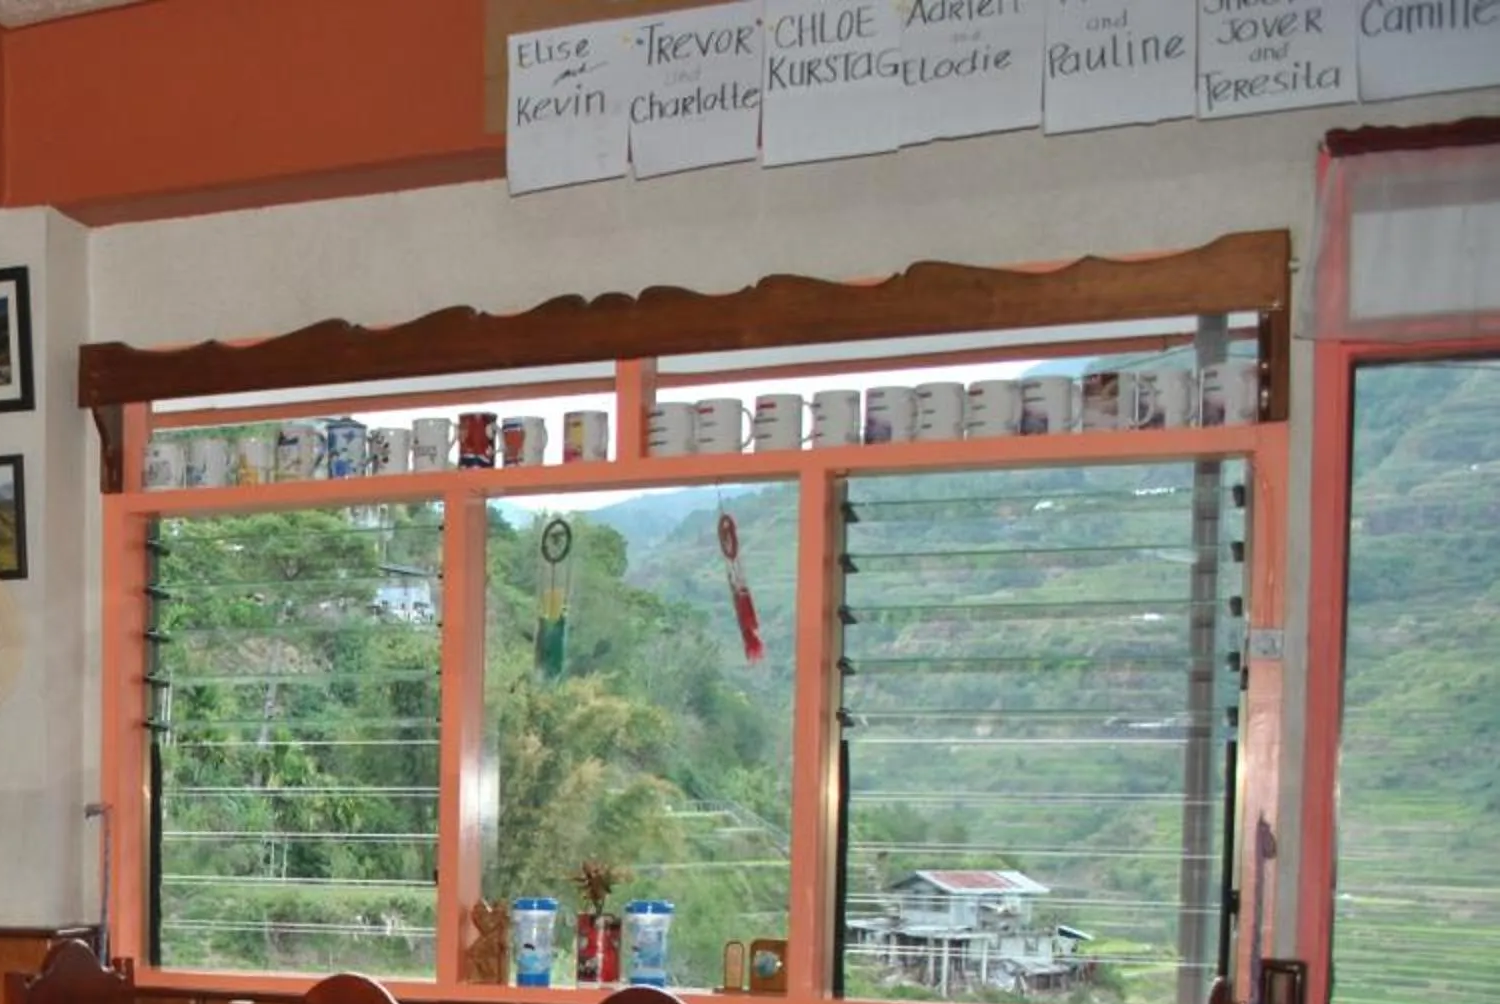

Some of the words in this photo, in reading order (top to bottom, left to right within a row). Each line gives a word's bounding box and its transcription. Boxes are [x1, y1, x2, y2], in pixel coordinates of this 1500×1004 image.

[774, 5, 880, 48] CHLOE
[1085, 8, 1128, 31] and
[1049, 31, 1186, 80] Pauline
[1248, 42, 1290, 62] and
[516, 84, 606, 127] Kevin
